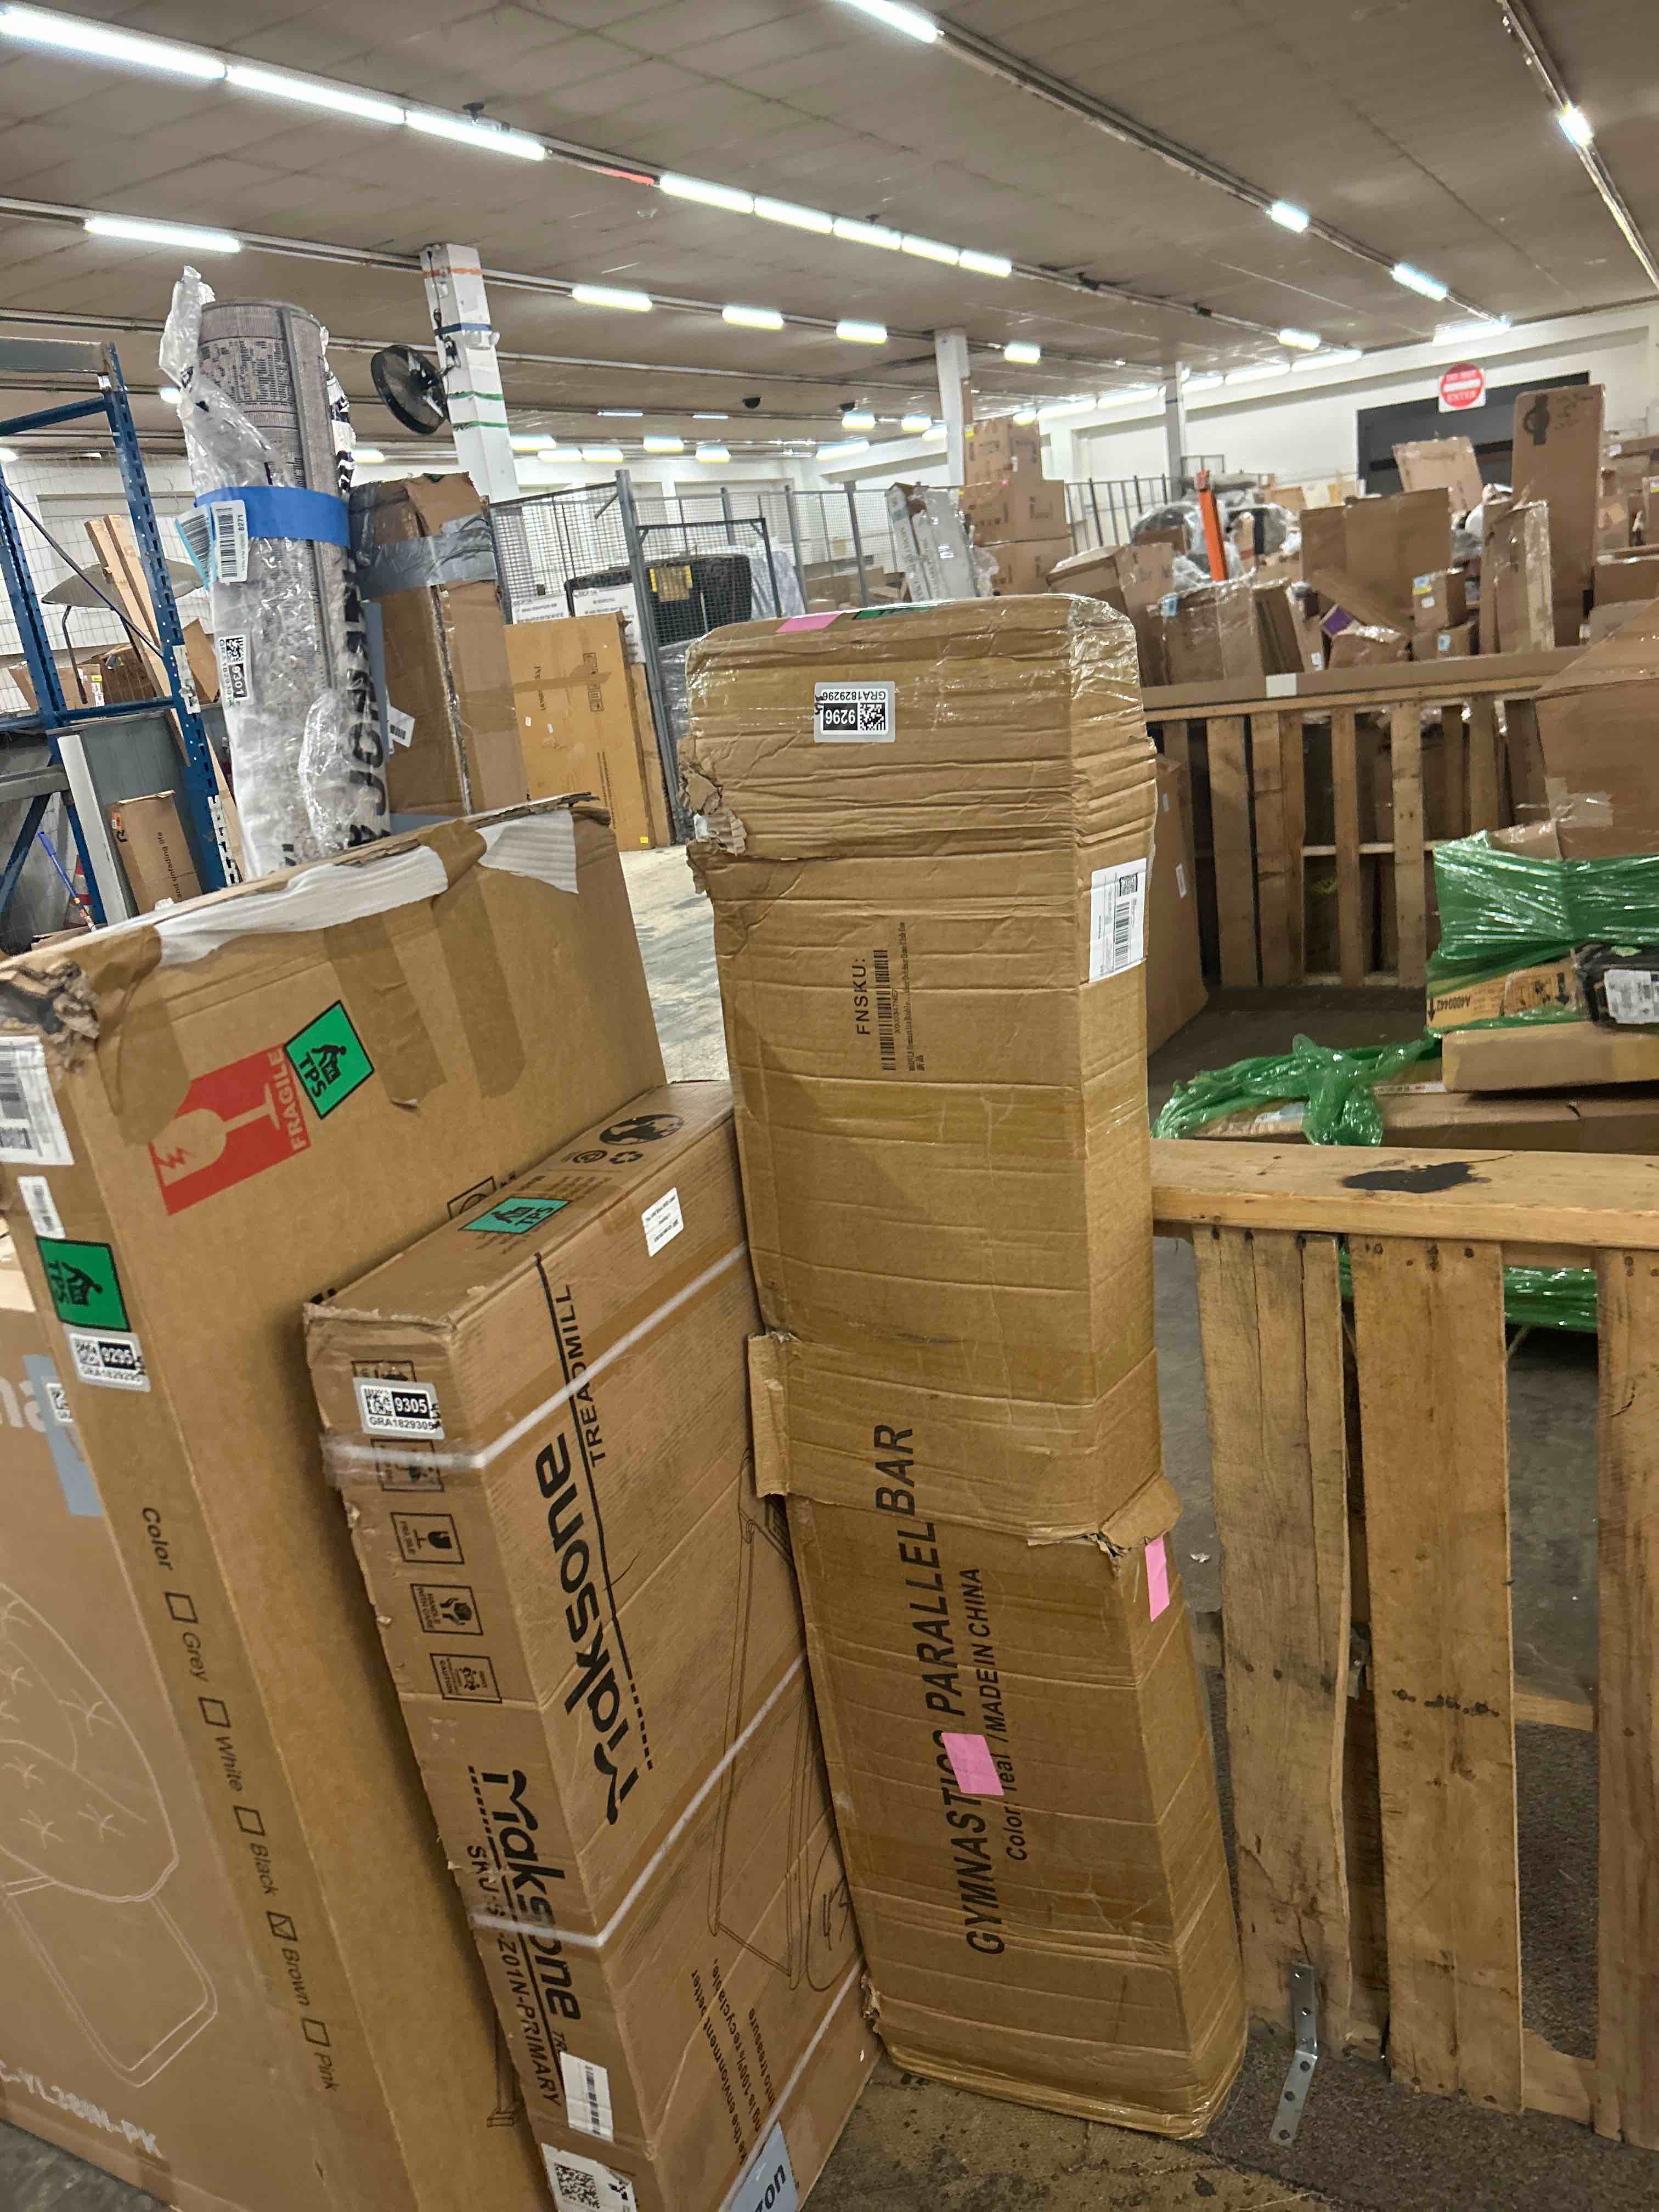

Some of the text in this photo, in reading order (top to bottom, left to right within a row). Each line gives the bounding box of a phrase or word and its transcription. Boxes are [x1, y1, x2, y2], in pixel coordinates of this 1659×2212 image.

[232, 665, 245, 695] 9301
[823, 691, 886, 701] GRA1829296
[825, 709, 856, 724] 9296
[851, 959, 870, 1035] FNSKU:
[298, 1052, 327, 1098] TPS
[268, 1052, 307, 1150] FRAGILE
[516, 1207, 554, 1226] TPS
[555, 1285, 606, 1468] TREADMILL
[394, 1396, 428, 1414] 9305
[874, 1425, 915, 1515] BAR
[421, 1608, 433, 1629] CARE
[427, 1593, 441, 1624] HANDLE
[897, 1522, 966, 1717] PARALLEL
[960, 1569, 991, 1638] CHINA
[439, 1660, 454, 1694] CAUTION
[971, 1643, 995, 1666] IN
[142, 1507, 340, 2092] Color Grey White Black Brown Pink
[690, 1969, 708, 2016] better
[709, 1957, 742, 2050] recyclable,
[736, 2051, 752, 2096] 100%
[747, 2007, 776, 2106] into treasure
[731, 2115, 743, 2141] the
